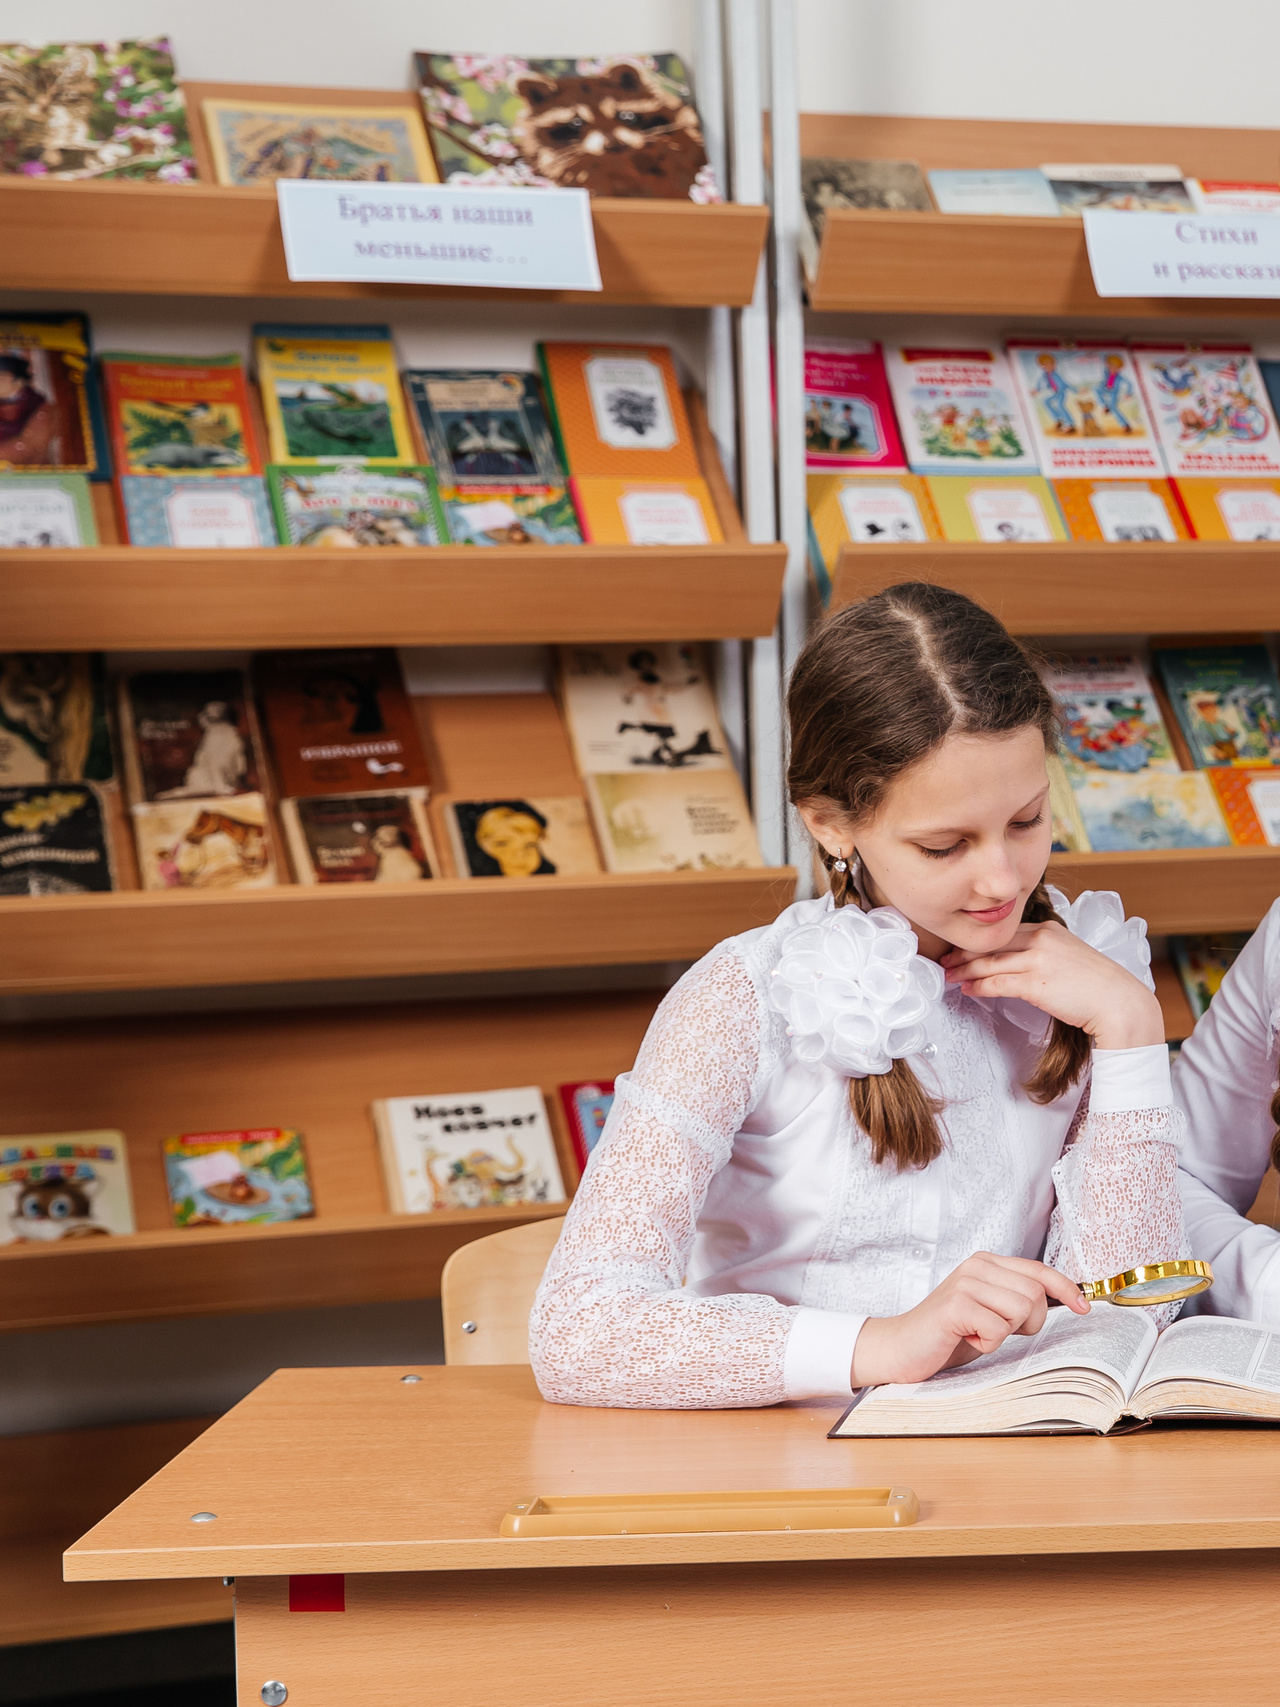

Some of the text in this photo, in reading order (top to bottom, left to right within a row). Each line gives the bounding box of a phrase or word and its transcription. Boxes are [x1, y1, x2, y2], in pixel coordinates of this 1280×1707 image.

[338, 194, 534, 226] Братья наши
[1174, 219, 1259, 245] Стихи
[1153, 262, 1169, 278] и
